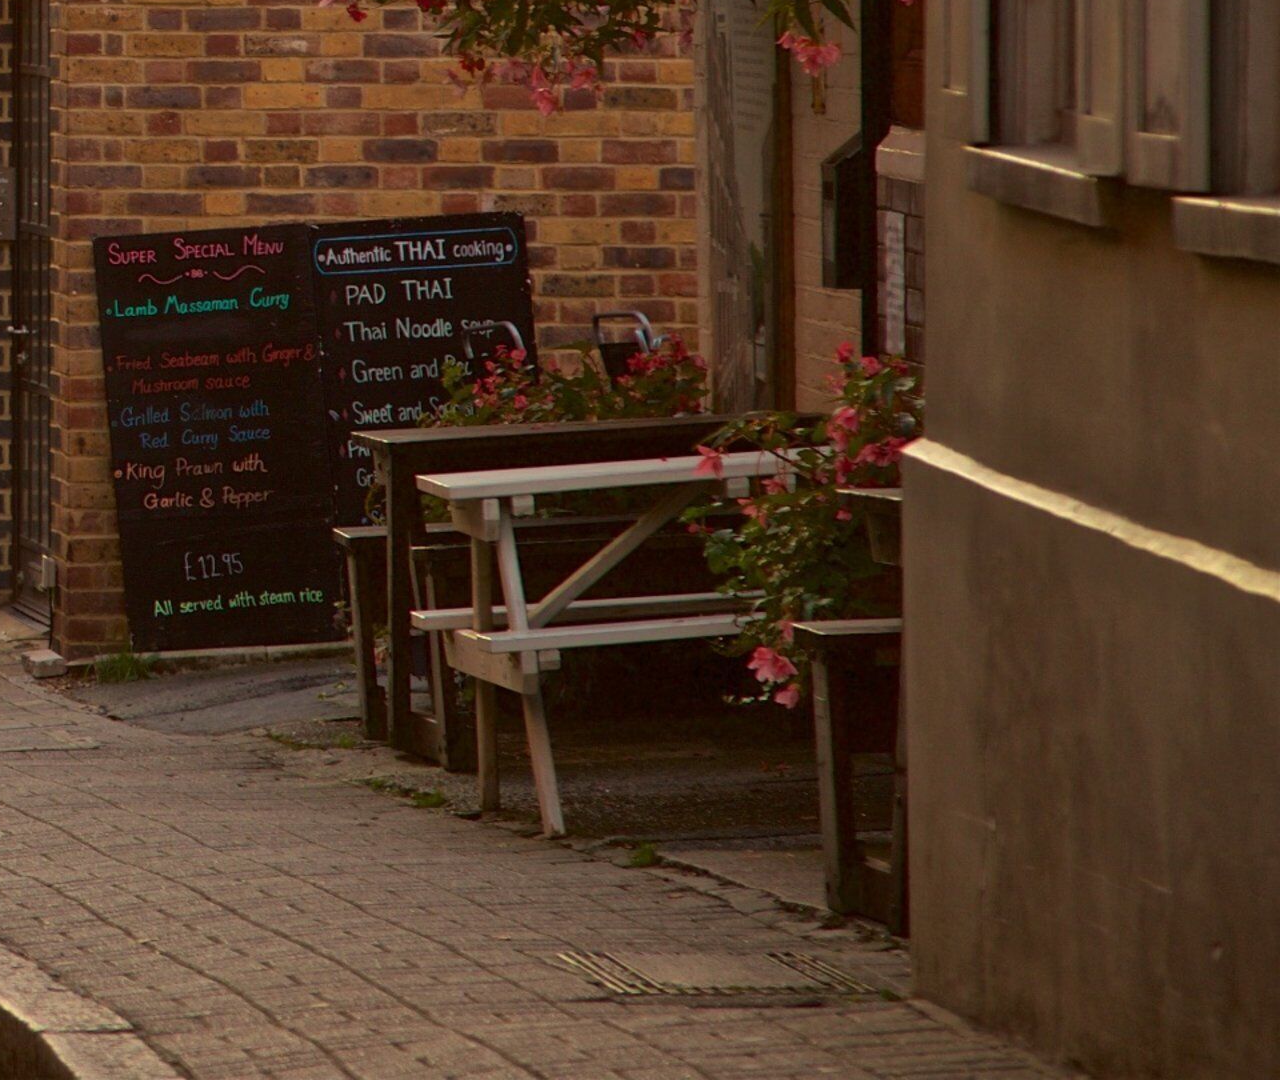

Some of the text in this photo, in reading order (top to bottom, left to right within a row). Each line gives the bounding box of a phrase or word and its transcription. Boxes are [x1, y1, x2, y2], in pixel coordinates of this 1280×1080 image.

[108, 233, 284, 265] SUPER SPECIAL MENU
[325, 238, 504, 266] Authentic THAI cooking
[113, 286, 290, 317] Lamb Massaman Curry
[345, 277, 454, 306] PAD THAI
[343, 321, 388, 342] Thai
[396, 317, 454, 339] Noodle
[115, 354, 152, 370] Fried
[226, 348, 257, 364] with
[262, 342, 302, 367] Ginger
[303, 343, 316, 361] &
[351, 359, 403, 383] Green
[410, 357, 439, 379] and
[131, 374, 251, 395] Mushroom sauce
[120, 404, 170, 428] Grilled
[239, 399, 270, 418] with
[351, 401, 394, 425] Sweet
[398, 400, 423, 421] and
[140, 424, 271, 450] Red Curry Sauce
[125, 452, 268, 489] King Prawn with
[143, 485, 274, 509] Garlic & Pepper
[153, 587, 324, 618] All served with steam rice
